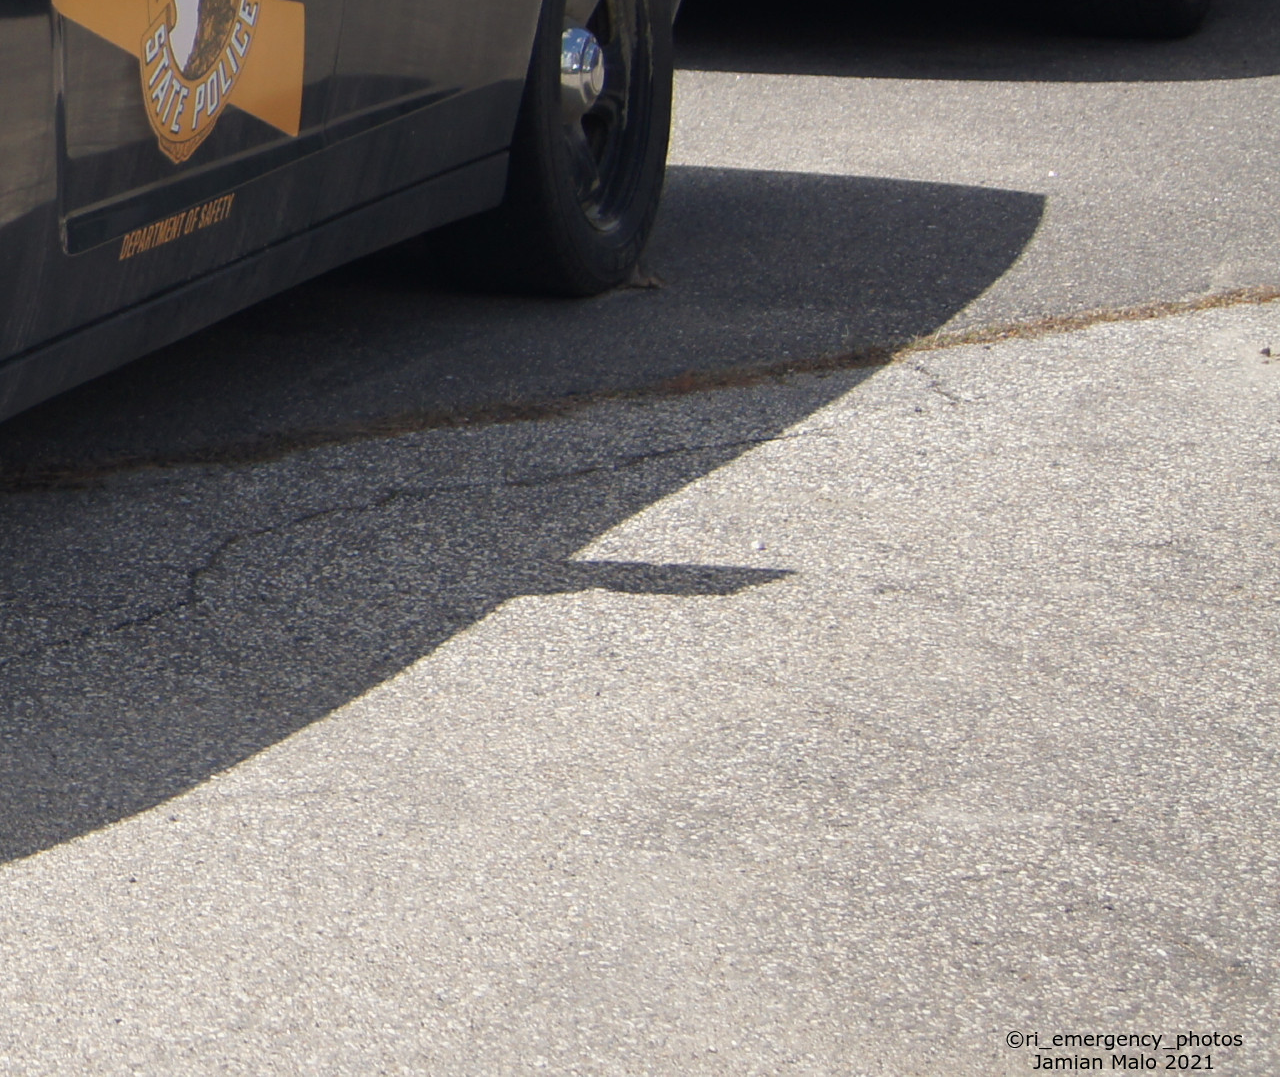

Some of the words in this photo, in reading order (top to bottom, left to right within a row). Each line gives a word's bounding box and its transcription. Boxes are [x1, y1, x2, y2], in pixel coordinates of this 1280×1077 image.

[145, 23, 189, 134] STATE
[119, 212, 187, 261] DEPARTMENT
[184, 206, 201, 235] OF
[198, 192, 236, 229] SAFETY
